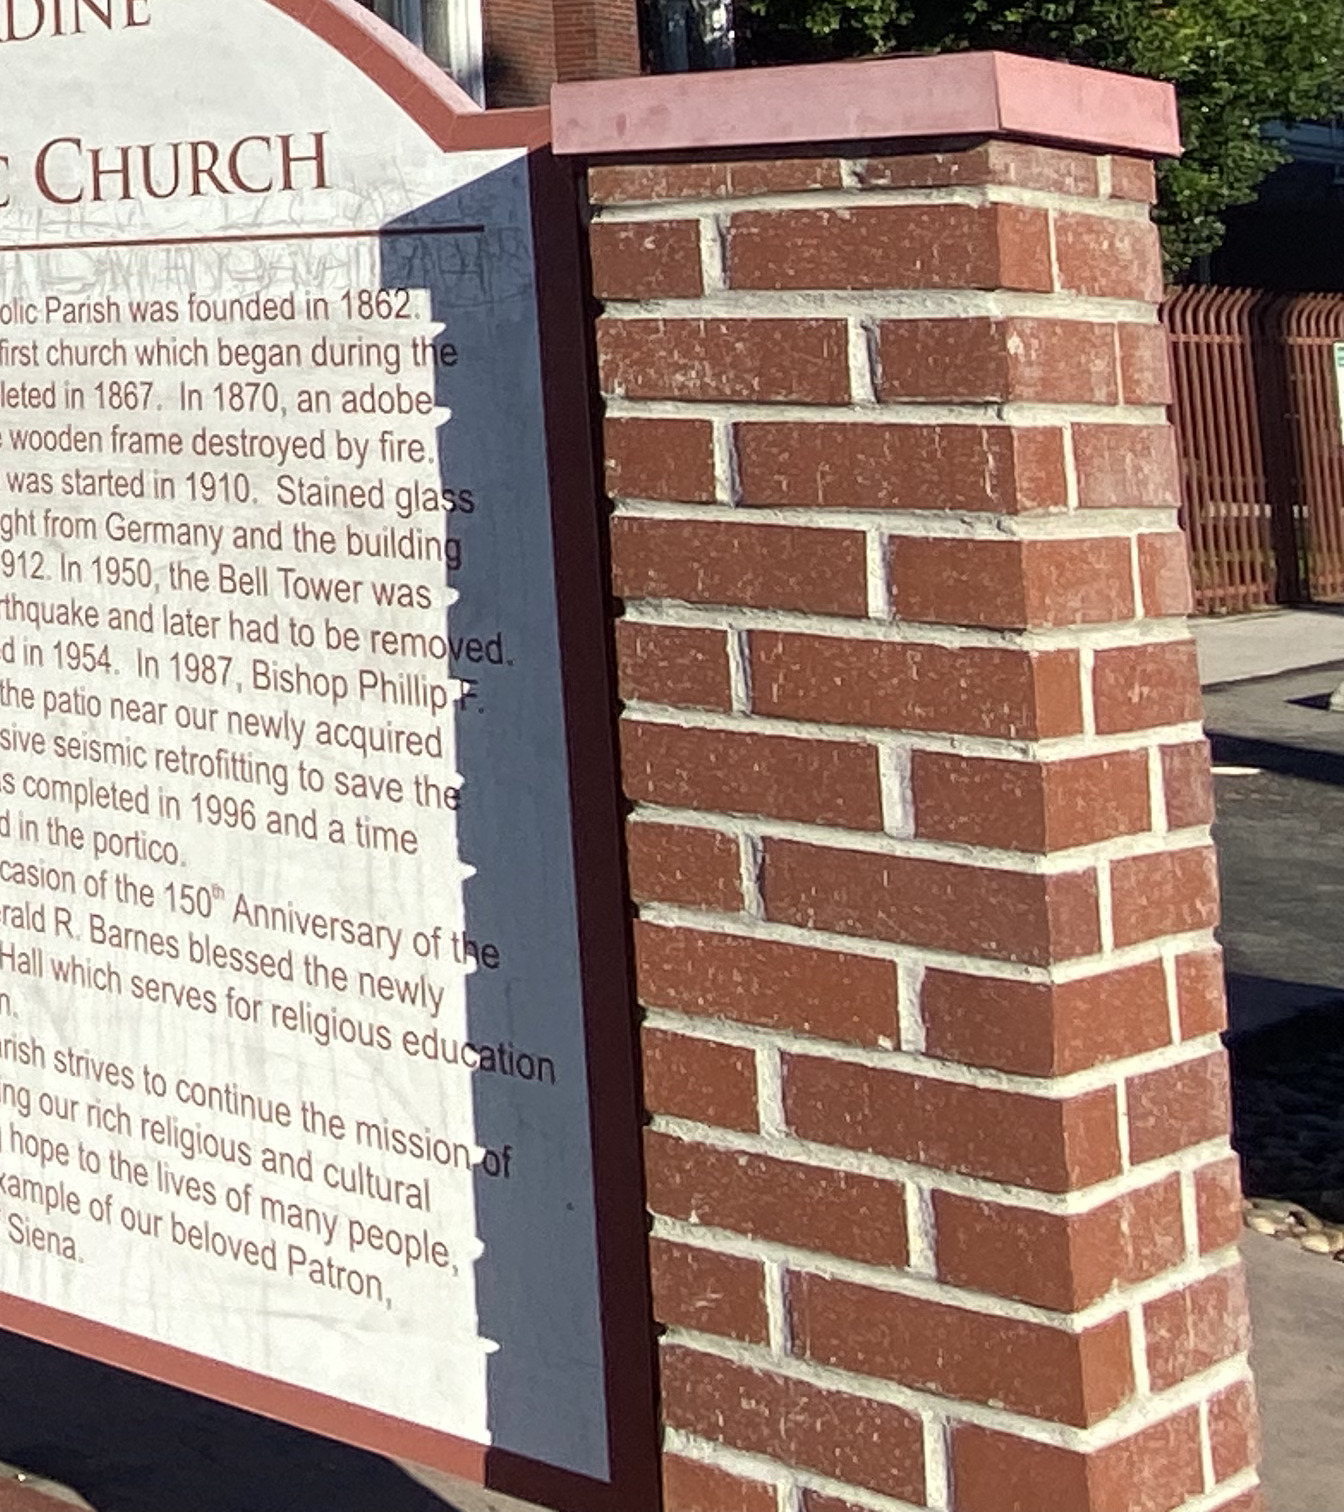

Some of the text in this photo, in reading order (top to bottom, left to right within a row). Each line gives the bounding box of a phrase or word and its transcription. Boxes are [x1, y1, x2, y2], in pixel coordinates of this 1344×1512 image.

[34, 130, 332, 206] CHURCH
[45, 295, 121, 325] Parish
[129, 301, 179, 323] was
[188, 292, 296, 322] founded
[305, 290, 329, 320] in
[342, 288, 420, 320] 1862.
[46, 338, 127, 366] church
[134, 337, 208, 366] which
[218, 337, 302, 374] began
[311, 336, 400, 375] during
[411, 338, 459, 367] the
[9, 424, 102, 453] wooden
[111, 424, 183, 455] frame
[192, 427, 325, 466] destroyed
[336, 429, 369, 470] by
[379, 430, 434, 464] fire.
[6, 472, 53, 494] was
[62, 468, 145, 498] started
[154, 469, 175, 500] in
[186, 471, 258, 505] 1910.
[277, 474, 384, 509] Stained
[395, 480, 476, 519] glass
[43, 508, 96, 539] from
[105, 512, 224, 556] Germany
[233, 520, 282, 551] and
[293, 522, 336, 554] the
[347, 524, 462, 571] building
[108, 603, 154, 633] and
[163, 604, 221, 639] later
[229, 610, 279, 644] had
[289, 617, 315, 648] to
[325, 618, 360, 652] be
[371, 628, 514, 666] removed.
[0, 678, 35, 709] the
[43, 686, 101, 719] patio
[111, 698, 168, 725] near
[175, 705, 219, 731] our
[227, 709, 305, 751] newly
[316, 721, 442, 759] acquired
[53, 731, 147, 769] seismic
[155, 745, 288, 796] retrofitting
[298, 760, 324, 792] to
[334, 772, 403, 803] save
[414, 773, 461, 811] the
[19, 811, 39, 843] in
[47, 817, 84, 850] the
[93, 831, 186, 867] portico.
[23, 775, 149, 815] completed
[159, 786, 181, 820] in
[191, 792, 256, 831] 1996
[267, 808, 318, 840] and
[329, 819, 345, 845] a
[355, 816, 418, 855] time
[54, 906, 80, 940] R.
[90, 913, 179, 959] Barnes
[189, 931, 293, 982] blessed
[304, 955, 348, 992] the
[358, 972, 444, 1018] newly
[51, 955, 121, 994] which
[131, 975, 217, 1014] serves
[225, 986, 263, 1023] for
[272, 1001, 392, 1050] religious
[402, 1028, 556, 1086] education
[54, 1047, 135, 1090] strives
[143, 1064, 166, 1097] to
[176, 1078, 292, 1128] continue
[301, 1101, 345, 1140] the
[356, 1117, 471, 1171] mission
[482, 1145, 512, 1178] of
[39, 1092, 79, 1122] our
[87, 1098, 132, 1136] rich
[141, 1115, 252, 1166] religious
[261, 1148, 313, 1182] and
[324, 1162, 430, 1212] cultural
[8, 1213, 83, 1263] Siena.
[10, 1122, 69, 1169] hope
[78, 1142, 101, 1174] to
[109, 1150, 148, 1187] the
[157, 1160, 217, 1206] lives
[226, 1183, 252, 1215] of
[261, 1196, 338, 1246] many
[349, 1218, 458, 1277] people,
[89, 1194, 113, 1225] of
[121, 1206, 163, 1238] our
[171, 1211, 277, 1271] beloved
[288, 1244, 391, 1310] Patron,
